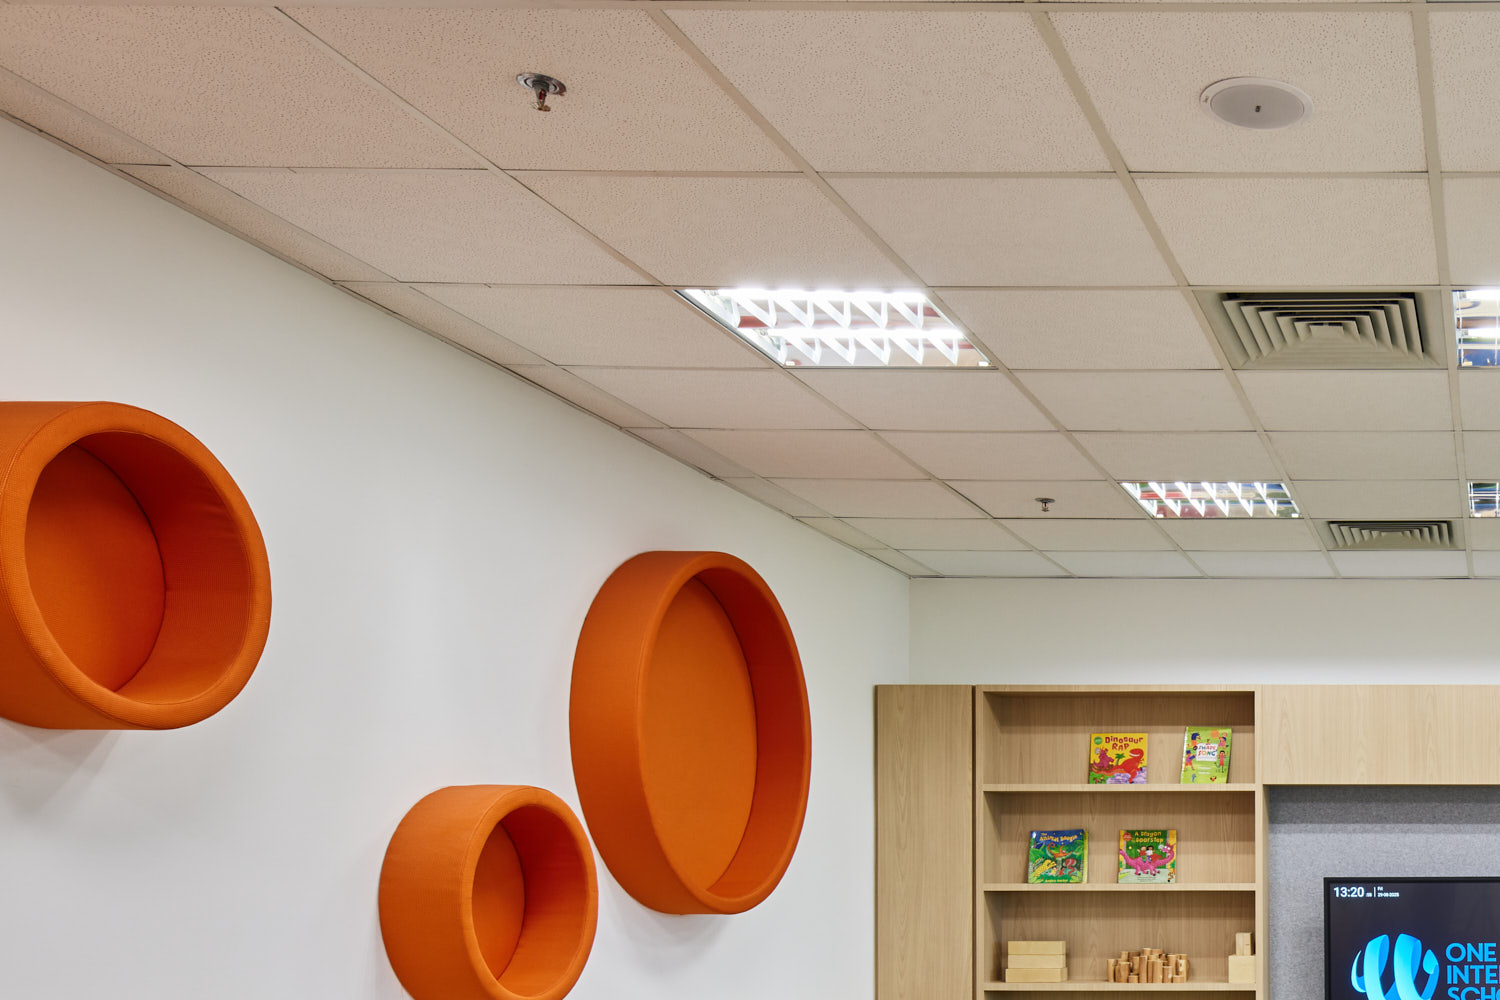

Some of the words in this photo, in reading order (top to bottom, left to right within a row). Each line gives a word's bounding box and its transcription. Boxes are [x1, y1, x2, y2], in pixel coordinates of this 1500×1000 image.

[1105, 736, 1144, 744] Dinosaur
[1333, 886, 1365, 898] 13:20
[1445, 942, 1497, 962] ONE
